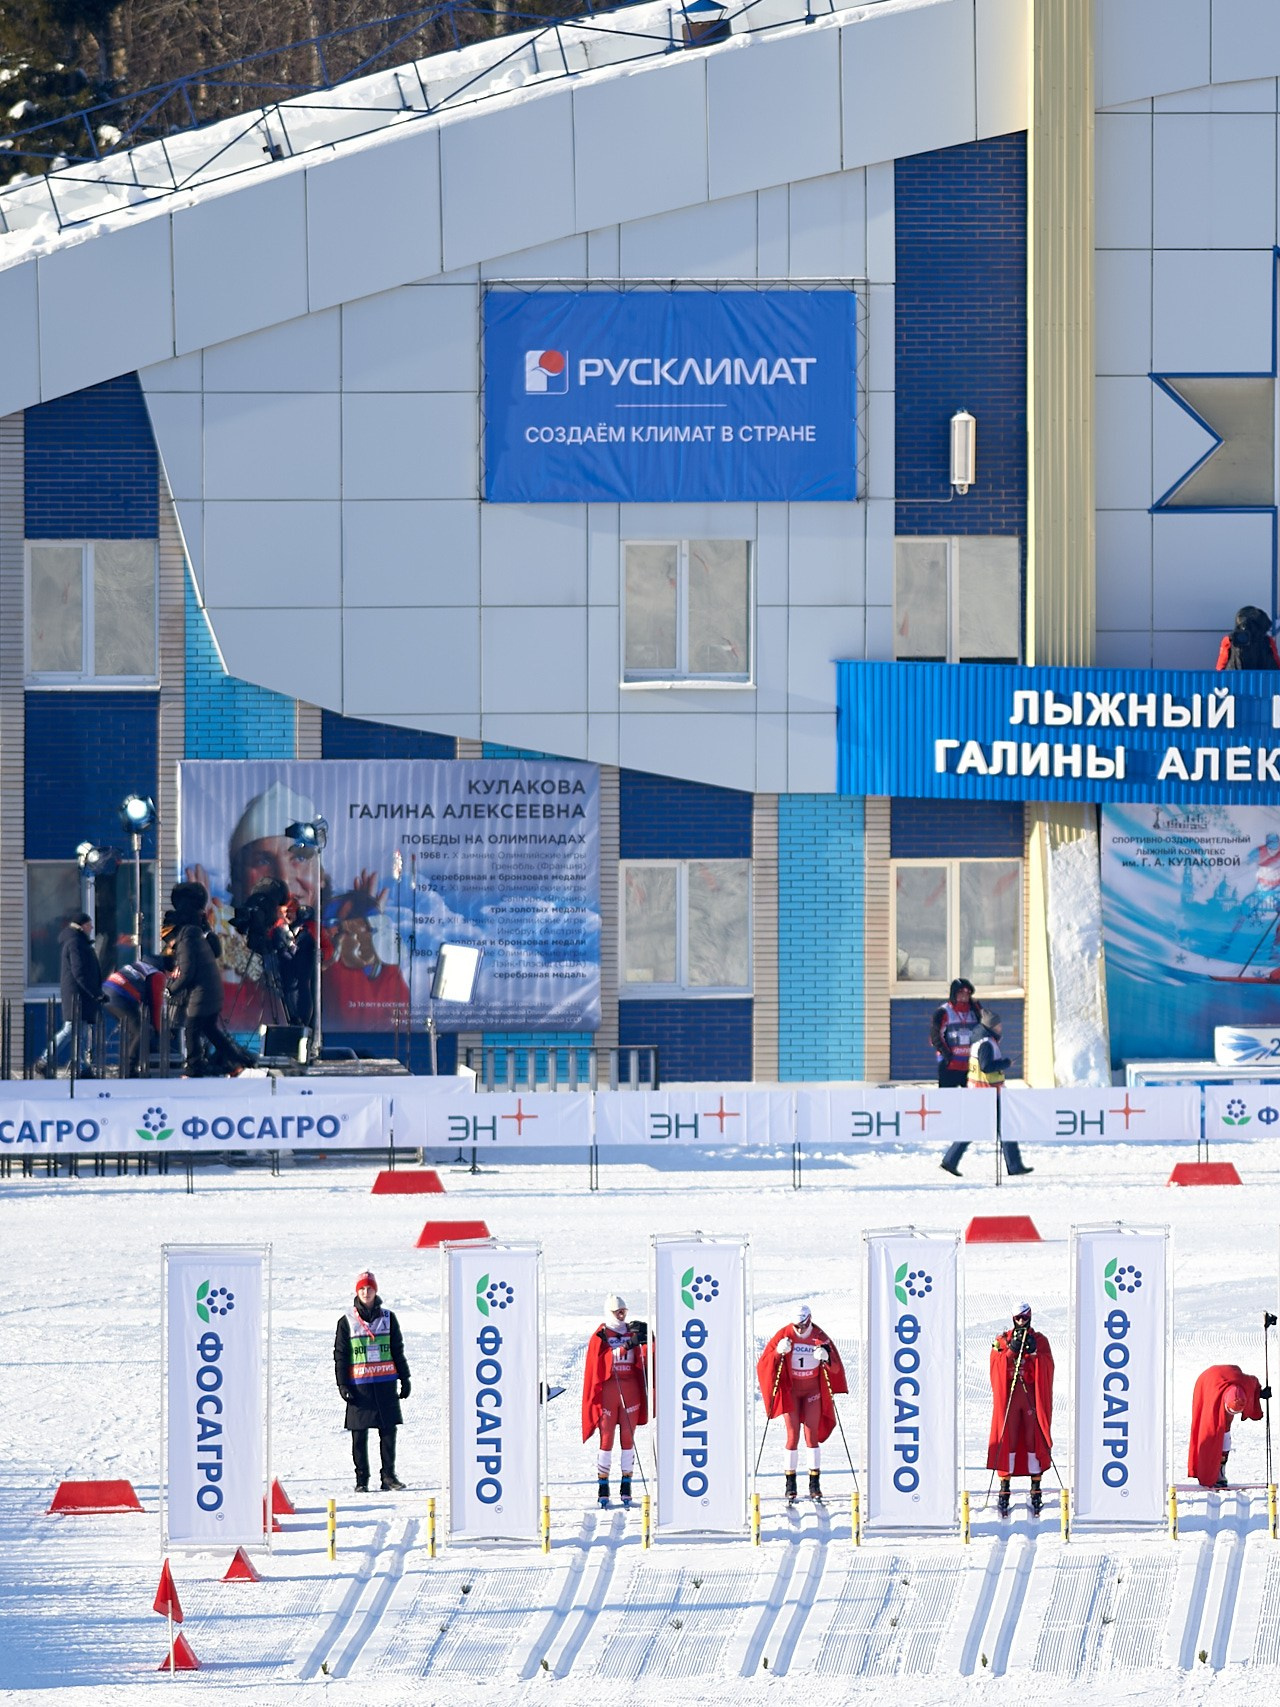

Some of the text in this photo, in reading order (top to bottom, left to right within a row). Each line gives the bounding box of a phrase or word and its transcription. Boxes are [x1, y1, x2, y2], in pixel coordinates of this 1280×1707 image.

[579, 357, 817, 386] РУСКЛИМАТ
[525, 422, 816, 445] СОЗДАЁМ КЛИМАТ В СТРАНЕ
[1009, 687, 1236, 729] ЛЫЖНЫЙ
[934, 739, 1126, 780] ГАЛИНЫ
[468, 779, 586, 795] КУЛАКОВА
[349, 803, 586, 819] ГАЛИНА АЛЕКСЕЕВНА
[401, 834, 586, 845] ПОБЕДЫ НА ОЛИМПИАДАХ
[1112, 834, 1251, 844] СПОРТИВНО-ОЗДОРОВИТЕЛЬНЫЙ
[1136, 846, 1177, 855] ЛЫЖНЫЙ
[1168, 856, 1241, 867] КУЛАКОВОЙ
[498, 938, 548, 946] бронзовая
[181, 1114, 341, 1140] ФОСАГРО
[798, 1357, 804, 1368] 1
[681, 1318, 709, 1497] ФОСАГРО
[893, 1313, 922, 1493] ФОСАГРО
[1101, 1308, 1130, 1488] ФОСАГРО
[196, 1331, 224, 1512] ФОСАГРО
[475, 1325, 503, 1505] ФОСАГРО
